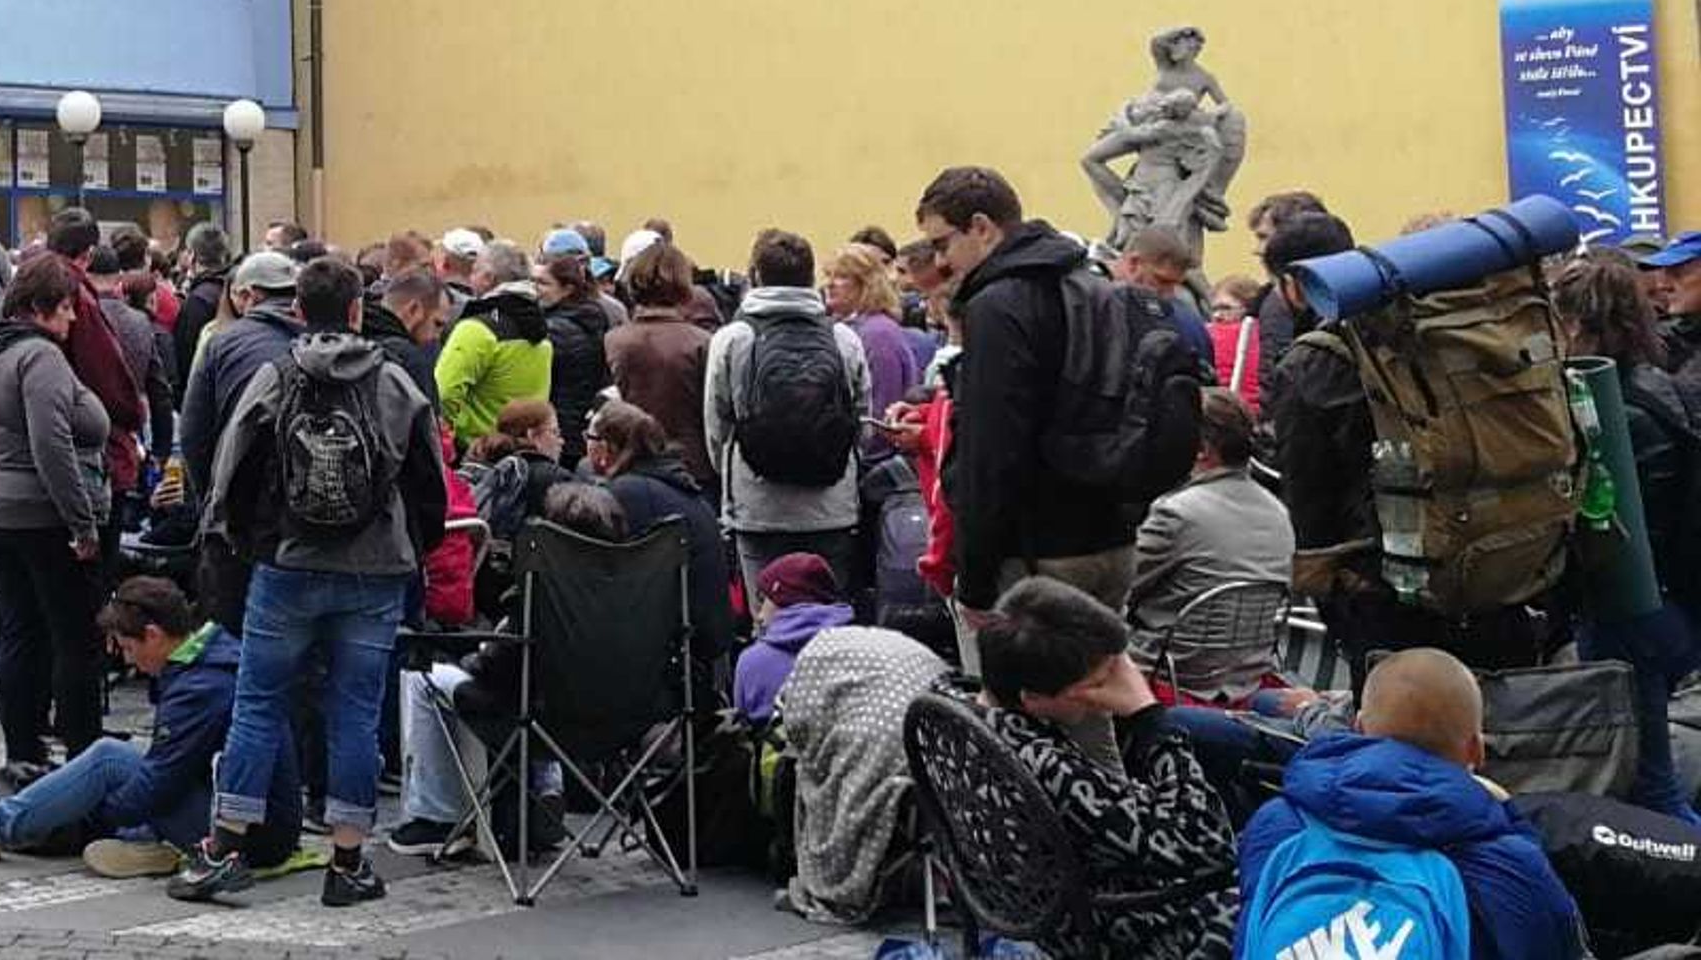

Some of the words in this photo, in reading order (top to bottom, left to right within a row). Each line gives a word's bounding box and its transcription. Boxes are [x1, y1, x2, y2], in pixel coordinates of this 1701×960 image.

[1612, 23, 1660, 238] HKUPECTVÍ
[1618, 833, 1696, 862] Outwell
[1276, 900, 1382, 960] IKE
